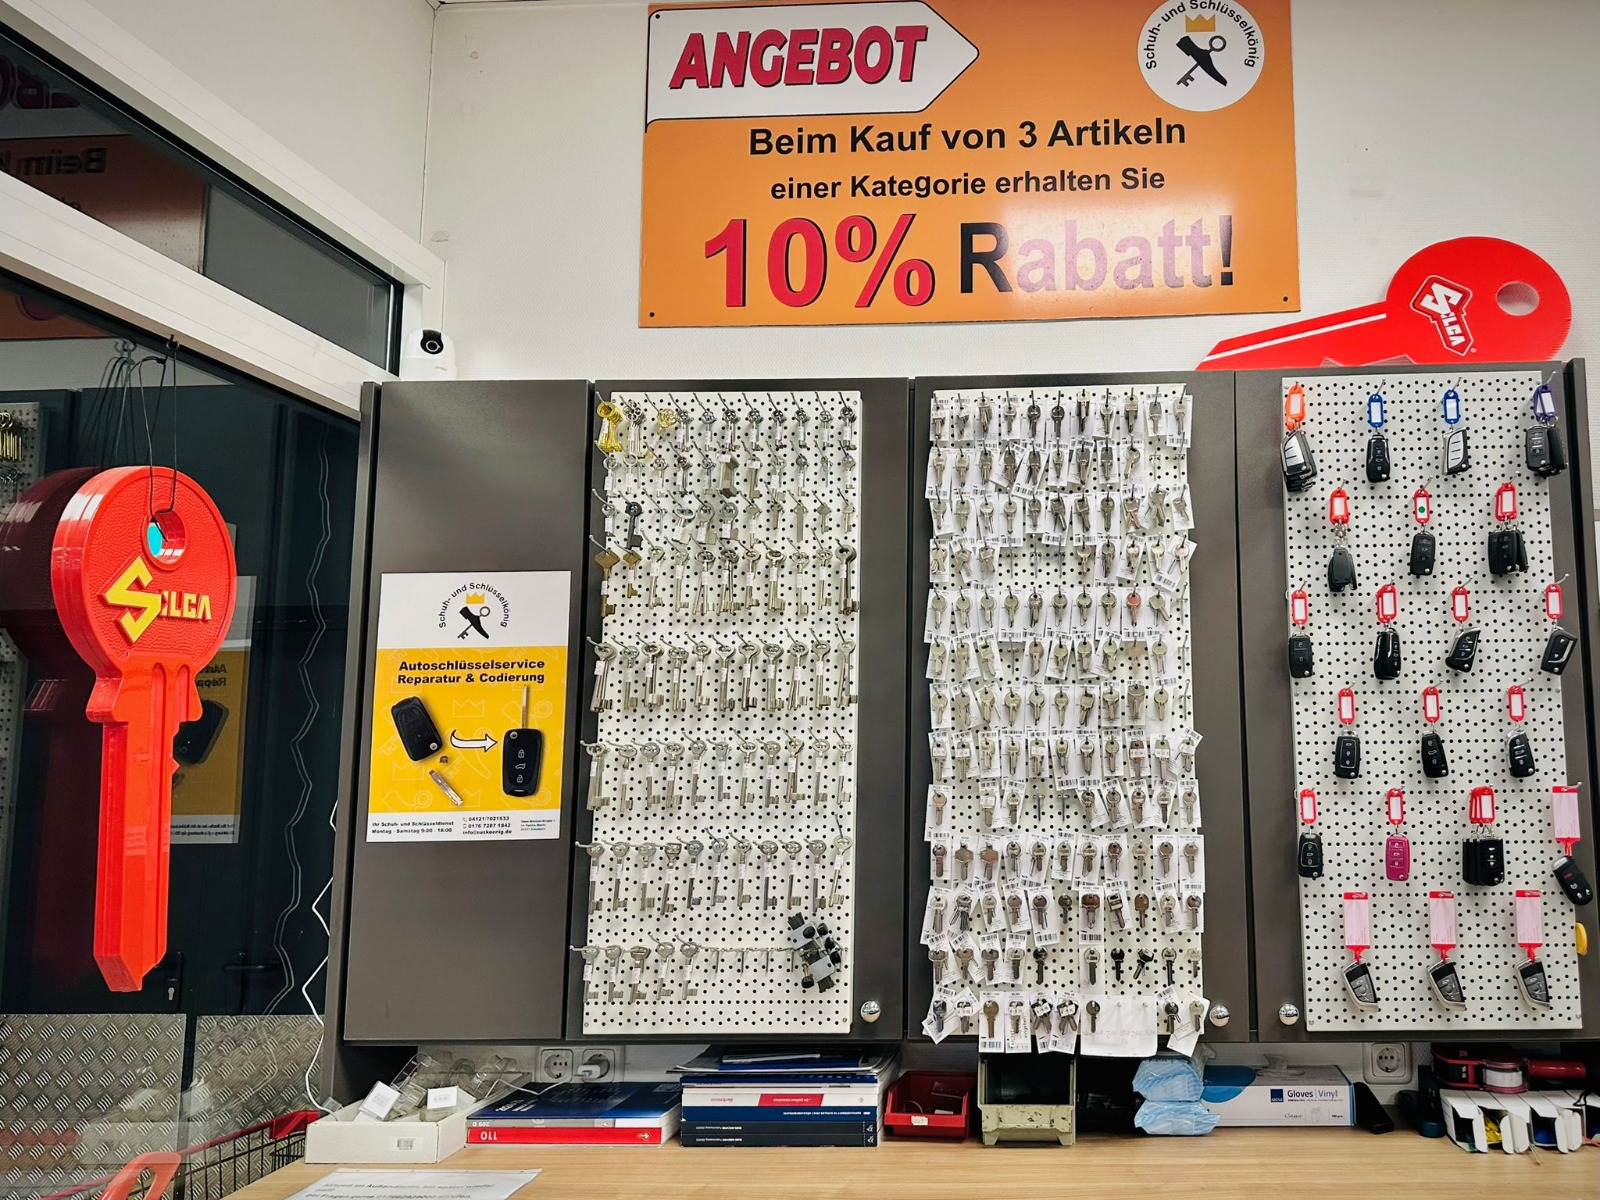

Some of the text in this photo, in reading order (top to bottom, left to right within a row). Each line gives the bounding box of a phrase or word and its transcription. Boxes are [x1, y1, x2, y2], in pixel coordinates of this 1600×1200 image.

[1143, 0, 1260, 70] Schuh- und Schlüsselkönig
[668, 24, 927, 89] ANGEBOT
[749, 118, 1186, 155] Beim Kauf von 3 Artikeln
[770, 167, 1165, 200] einer Kategorie erhalten Sie
[705, 212, 1234, 309] 10% Rabatt!
[438, 582, 511, 628] Schuh- und Schlüsselkönig
[397, 673, 545, 685] Reparatur & Codierung
[398, 659, 545, 671] Autoschlüsselservice
[1287, 1089, 1338, 1098] Gloves Vinyl
[480, 1131, 498, 1141] 110
